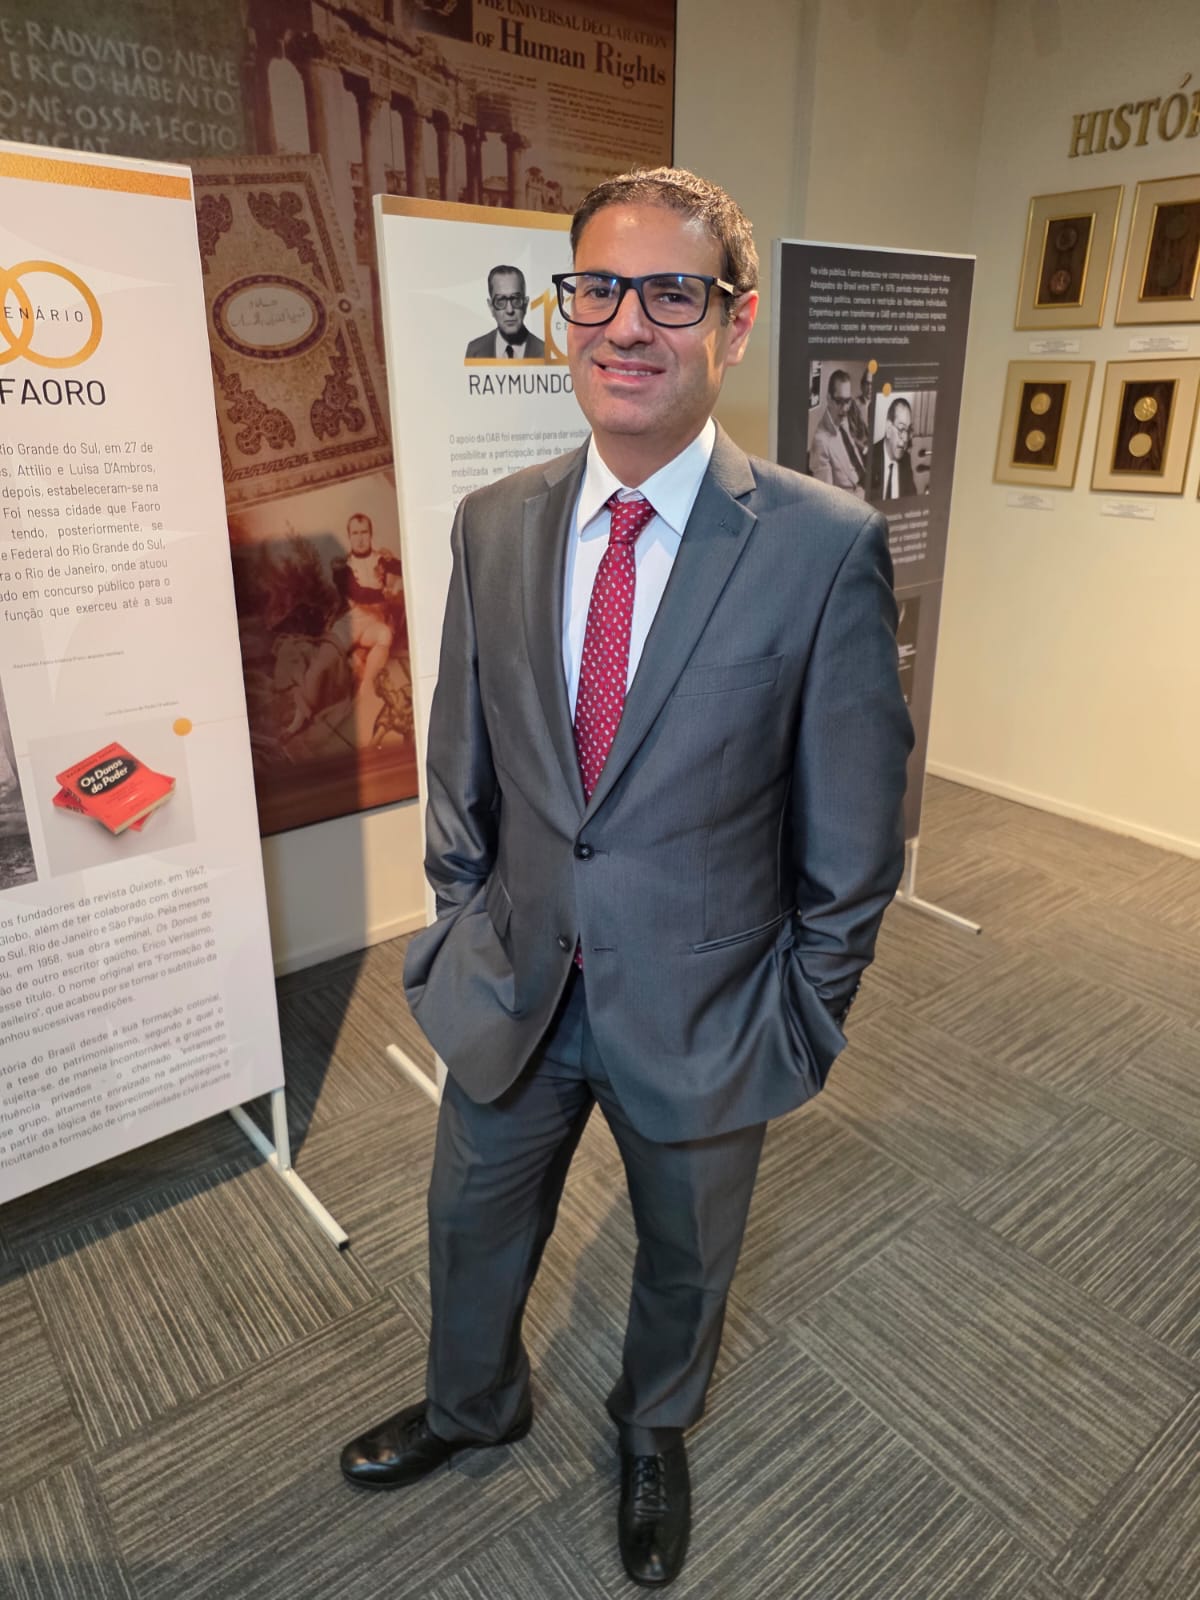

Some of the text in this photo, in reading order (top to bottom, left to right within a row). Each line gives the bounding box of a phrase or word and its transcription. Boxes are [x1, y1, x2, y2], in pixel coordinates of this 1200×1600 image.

[507, 0, 581, 31] UNIVERSAL
[582, 17, 667, 48] DECLARATION
[475, 31, 495, 48] OF
[499, 16, 586, 69] Human
[595, 40, 667, 89] Rights
[0, 378, 106, 406] FAORO
[469, 374, 573, 395] RAYMUNDO
[18, 442, 153, 455] Grande do Sul, em 27 de
[18, 464, 52, 476] Attilio
[57, 466, 64, 475] e
[2, 484, 158, 500] depois, estabeleceram-se na
[3, 501, 161, 519] Foi nessa cidade que Faoro
[11, 521, 163, 540] tendo, posteriormente, se
[11, 546, 53, 560] Federal
[56, 545, 69, 557] do
[72, 544, 90, 555] Rio
[92, 541, 129, 554] Grande
[132, 540, 144, 551] do
[147, 538, 165, 550] Sul,
[15, 571, 22, 580] o
[25, 567, 43, 580] Rio
[48, 566, 60, 578] de
[64, 562, 107, 577] Janeiro,
[111, 560, 136, 572] onde
[140, 560, 168, 570] atuou
[22, 590, 40, 600] em
[44, 585, 94, 598] concurso
[138, 579, 161, 591] para
[164, 578, 170, 586] o
[4, 596, 173, 622] função que exerceu até a sua
[80, 776, 95, 787] Os
[94, 759, 123, 779] Donos
[91, 767, 128, 794] do Poder
[17, 902, 75, 925] fundadores
[78, 897, 91, 908] da
[93, 888, 126, 904] revista
[169, 873, 183, 883] em
[62, 918, 74, 928] de
[77, 913, 91, 924] ter
[94, 897, 147, 918] colaborado
[149, 892, 169, 904] com
[171, 881, 208, 898] diversos
[29, 942, 46, 954] Rio
[48, 938, 60, 949] de
[62, 927, 100, 945] Janeiro
[108, 920, 127, 932] São
[157, 904, 177, 918] Pela
[178, 896, 210, 910] mesma
[17, 963, 34, 975] em
[66, 948, 85, 960] sua
[88, 940, 110, 953] obra
[16, 981, 29, 992] de
[32, 972, 60, 986] outro
[62, 959, 100, 977] escritor
[69, 976, 96, 991] nome
[100, 962, 134, 982] original
[45, 971, 159, 1015] que acabou por tornar
[32, 1010, 85, 1034] sucessivas
[31, 1055, 44, 1065] do
[48, 1041, 76, 1060] Brasil
[80, 1031, 109, 1049] desde
[142, 1007, 184, 1026] formação
[18, 1071, 40, 1086] tese
[45, 1065, 58, 1076] do
[58, 1075, 71, 1087] de
[51, 1083, 92, 1105] privados
[55, 1093, 103, 1118] altamente
[10, 1133, 38, 1152] partir
